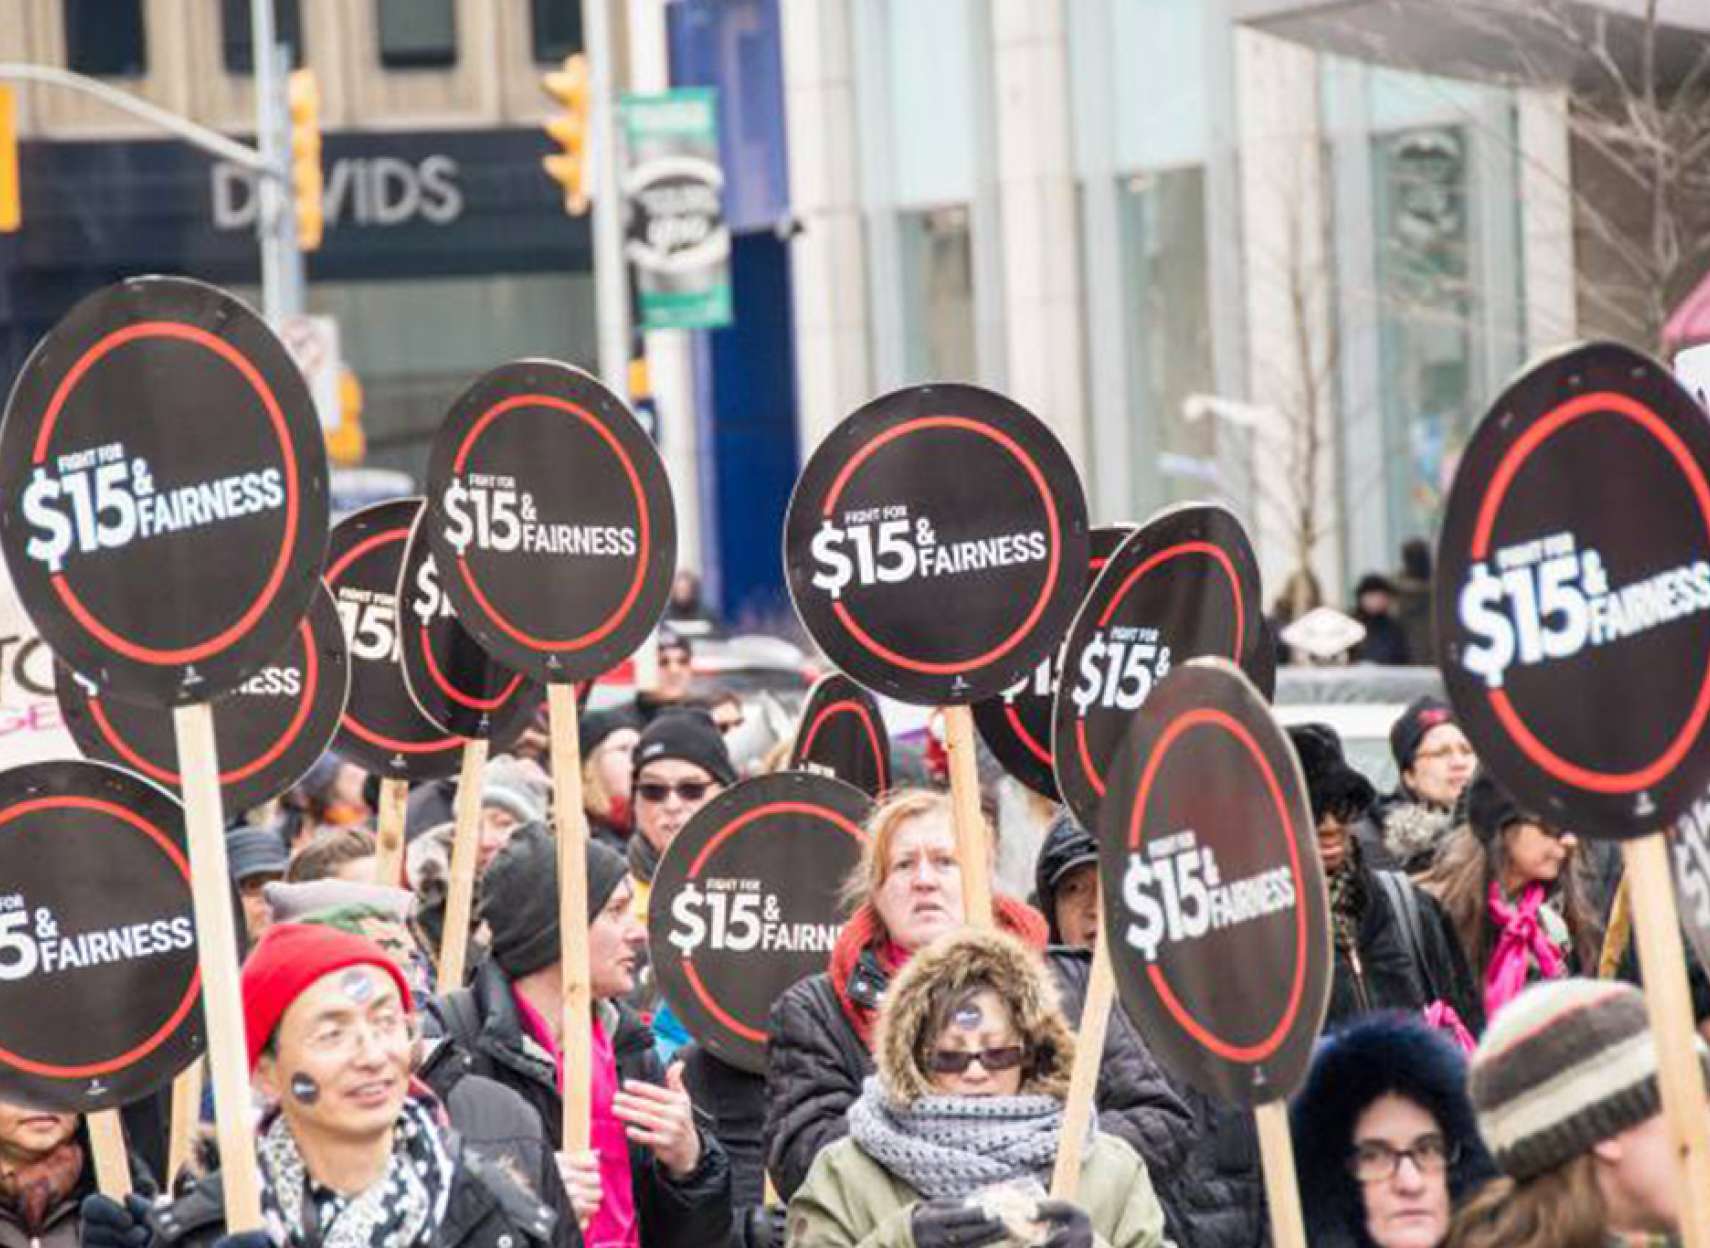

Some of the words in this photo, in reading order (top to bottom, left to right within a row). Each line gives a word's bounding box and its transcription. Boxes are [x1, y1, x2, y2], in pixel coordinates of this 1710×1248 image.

[210, 155, 464, 229] DVIDS
[57, 449, 97, 472] FIGHT
[98, 442, 124, 464] FOR
[22, 461, 138, 573] $15
[131, 458, 155, 496] &
[136, 468, 284, 538] FAIRNESS
[444, 478, 522, 556] $15
[521, 493, 537, 521] &
[522, 524, 637, 556] FAIRNESS
[844, 508, 880, 524] FIGHT
[883, 505, 908, 519] FOR
[811, 519, 917, 600] $15
[915, 517, 937, 546] &
[919, 531, 1047, 577] FAIRNESS
[1460, 555, 1590, 688] $15
[1588, 560, 1710, 646] FAIRNESS
[1072, 631, 1157, 718] $15
[35, 906, 58, 938] &
[40, 916, 193, 973] FAIRNESS
[668, 882, 761, 957] $15
[763, 894, 781, 922] &
[761, 922, 846, 951] FAIRN
[1123, 853, 1210, 962] $15
